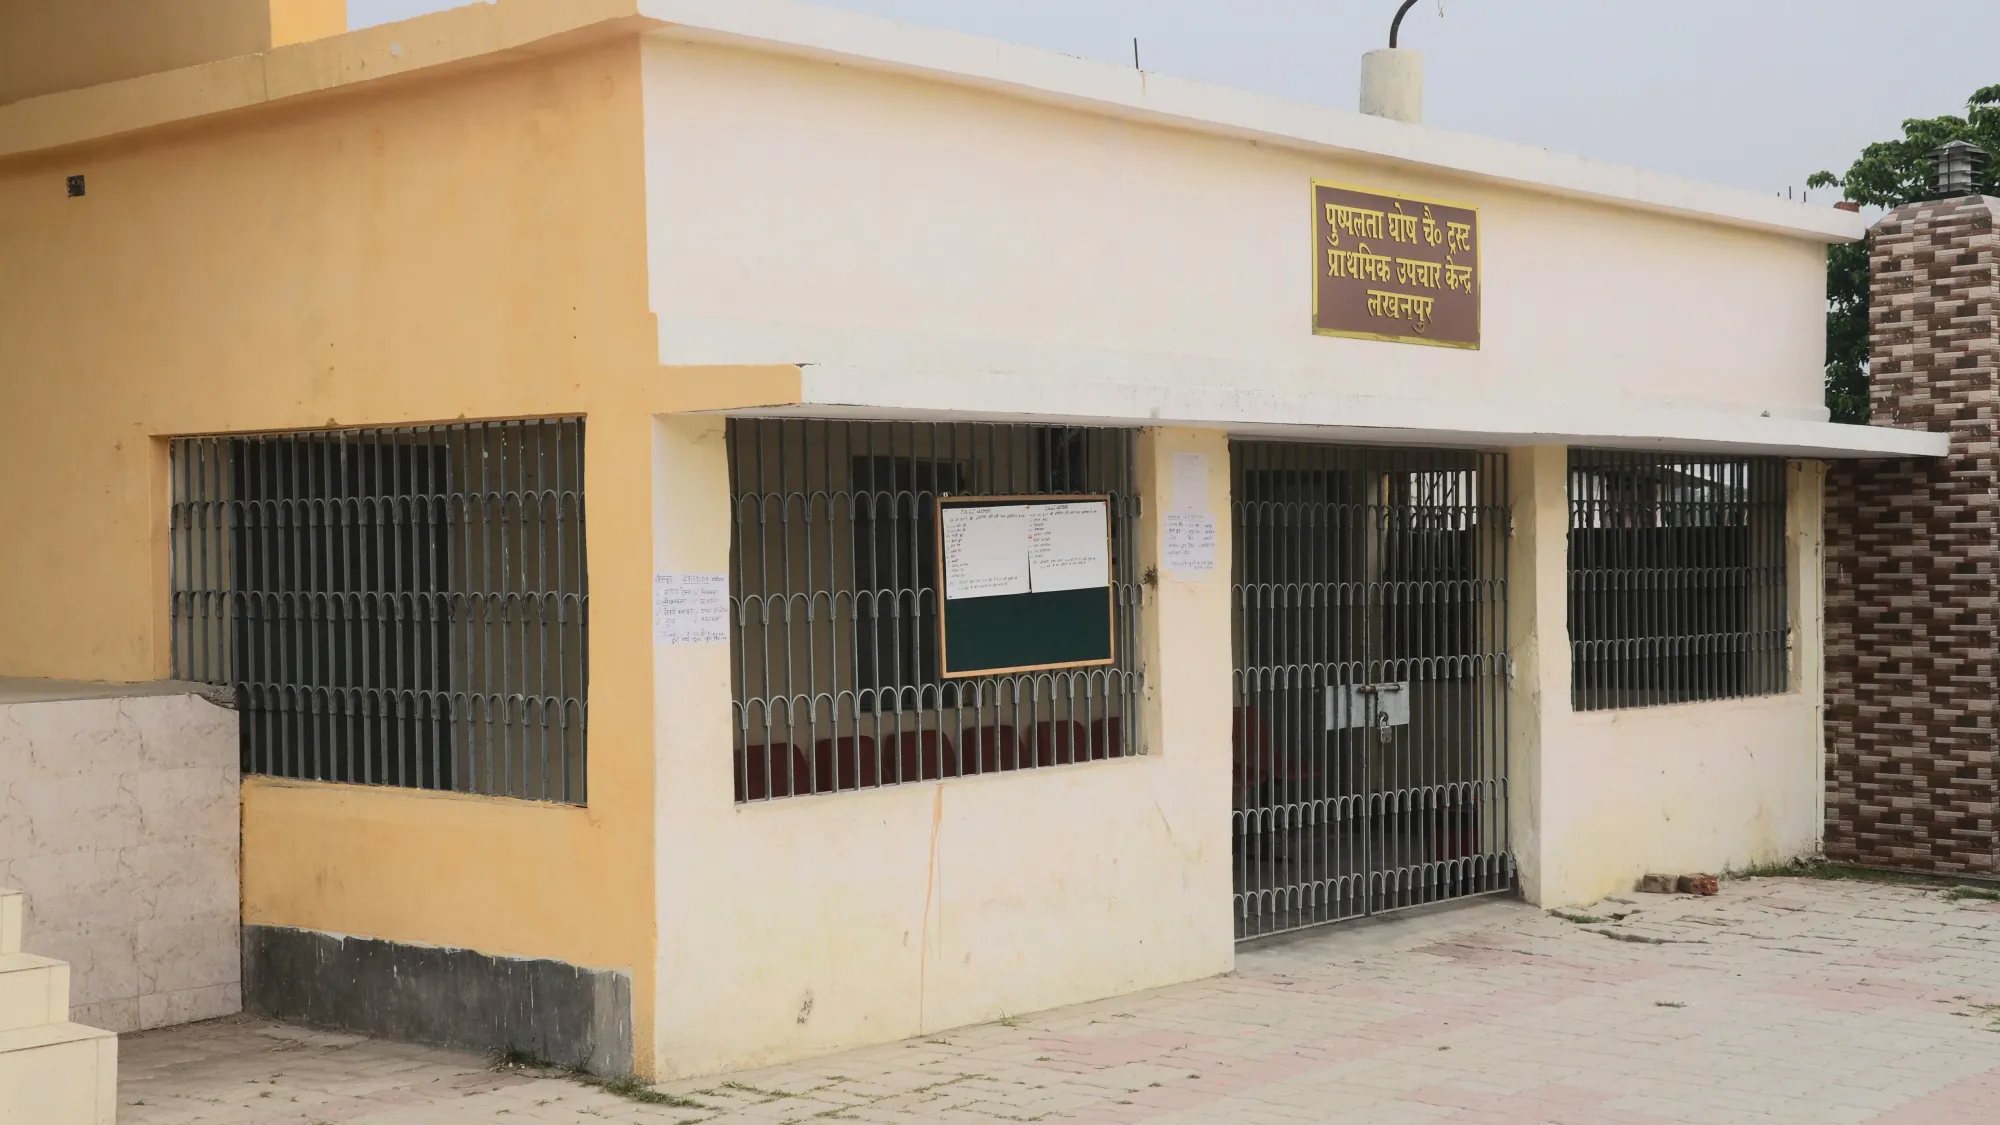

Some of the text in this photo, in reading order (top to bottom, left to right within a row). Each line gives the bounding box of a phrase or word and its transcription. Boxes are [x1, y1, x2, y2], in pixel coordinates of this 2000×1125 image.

[1325, 203, 1384, 246] पुष्पलता
[1388, 202, 1417, 244] घोष
[1447, 221, 1470, 254] ट्रस्ट
[1328, 242, 1472, 294] प्राथमिक उपचार केन्द्र
[1367, 289, 1434, 333] लखनपुर
